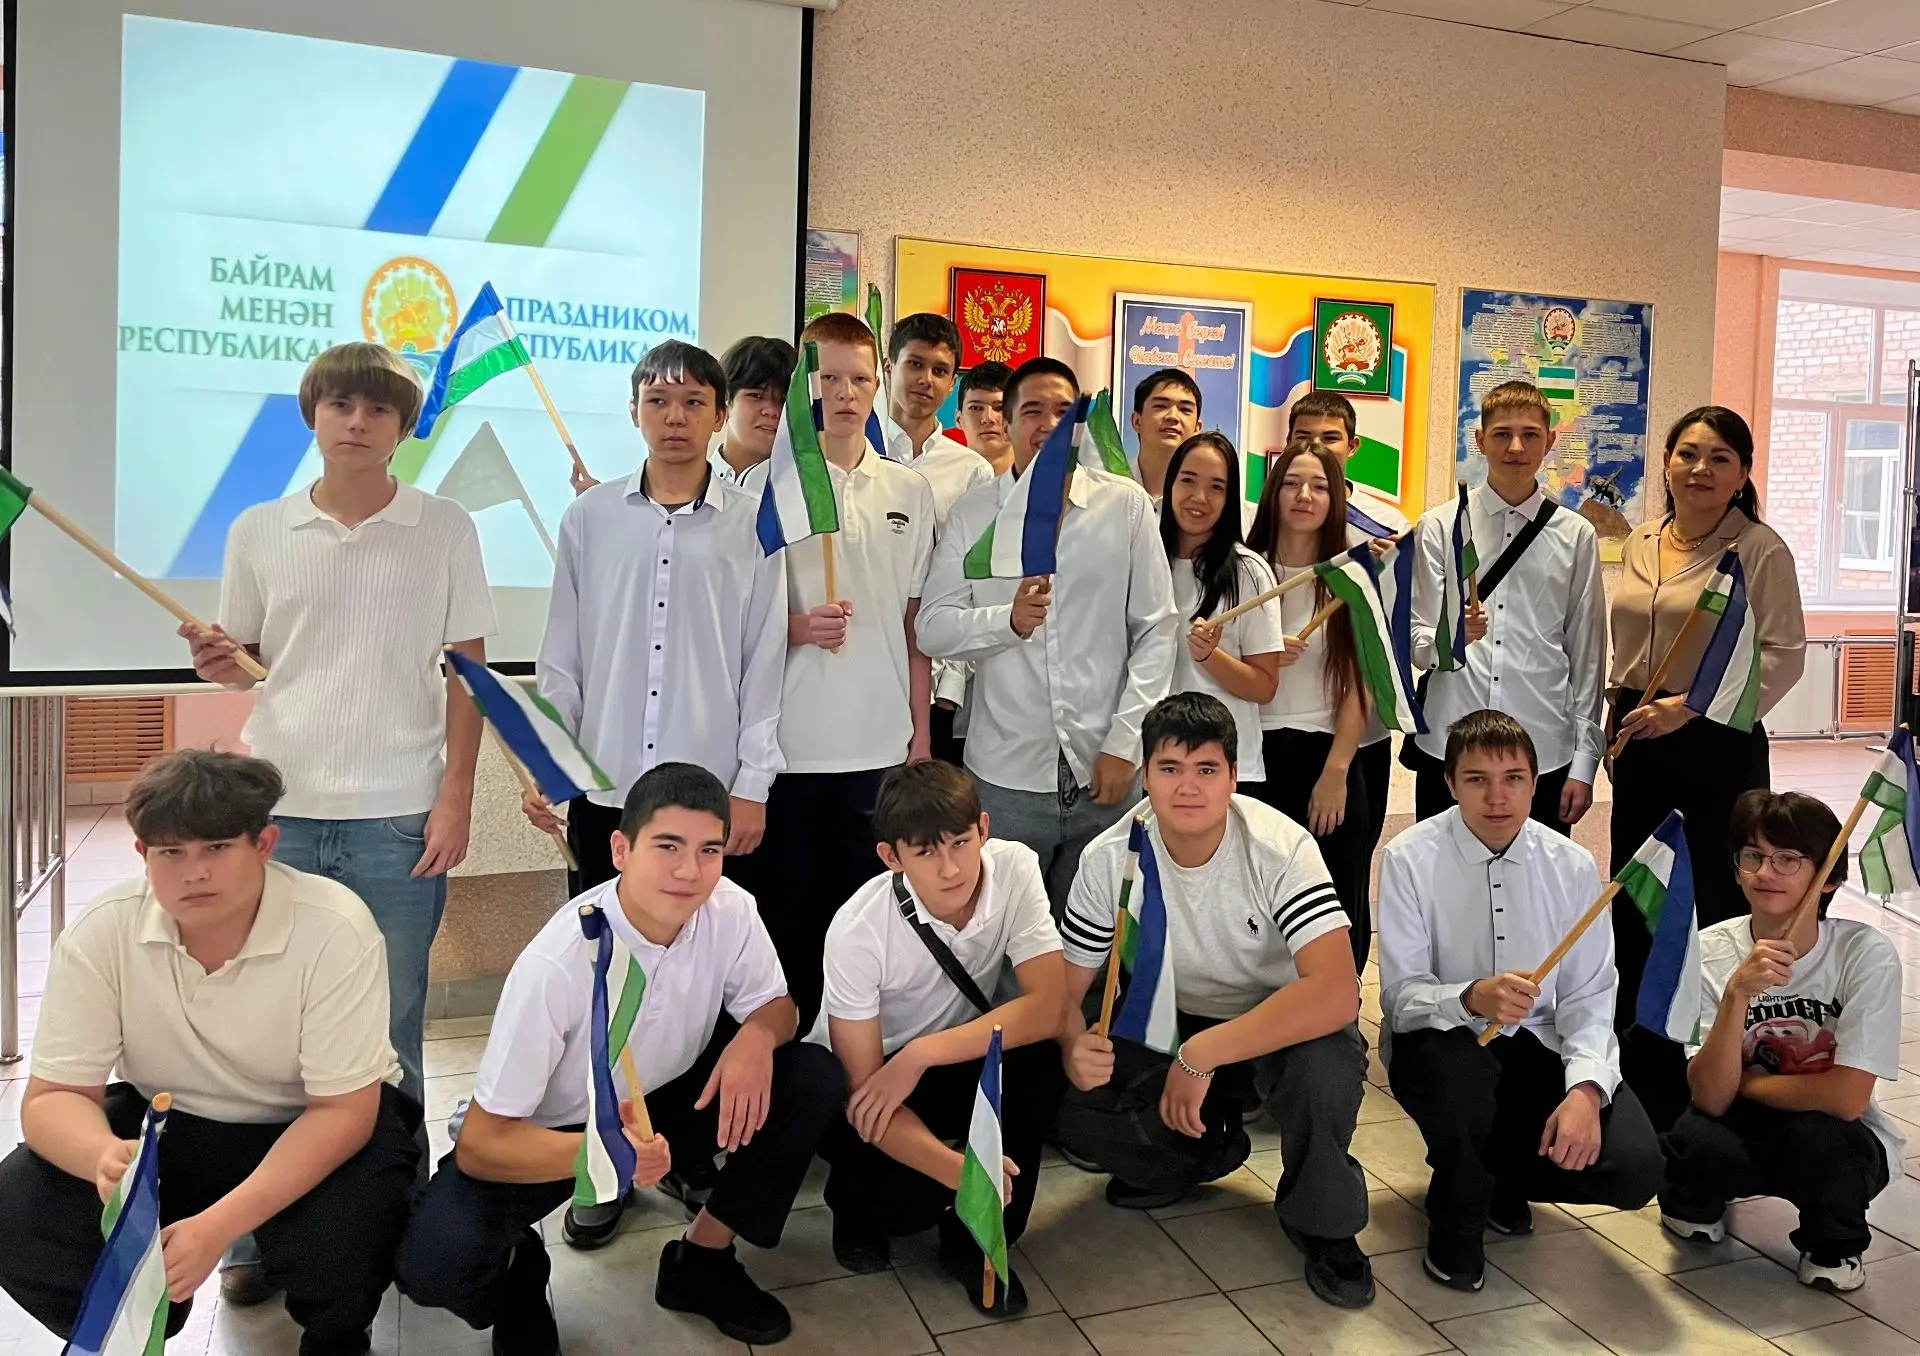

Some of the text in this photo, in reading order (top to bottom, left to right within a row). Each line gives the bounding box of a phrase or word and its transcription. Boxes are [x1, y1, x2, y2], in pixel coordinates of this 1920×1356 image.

[209, 254, 335, 292] БАЙРАМ
[219, 295, 334, 328] МЕНӘН
[505, 297, 696, 340] ПРАЗДНИКОМ,
